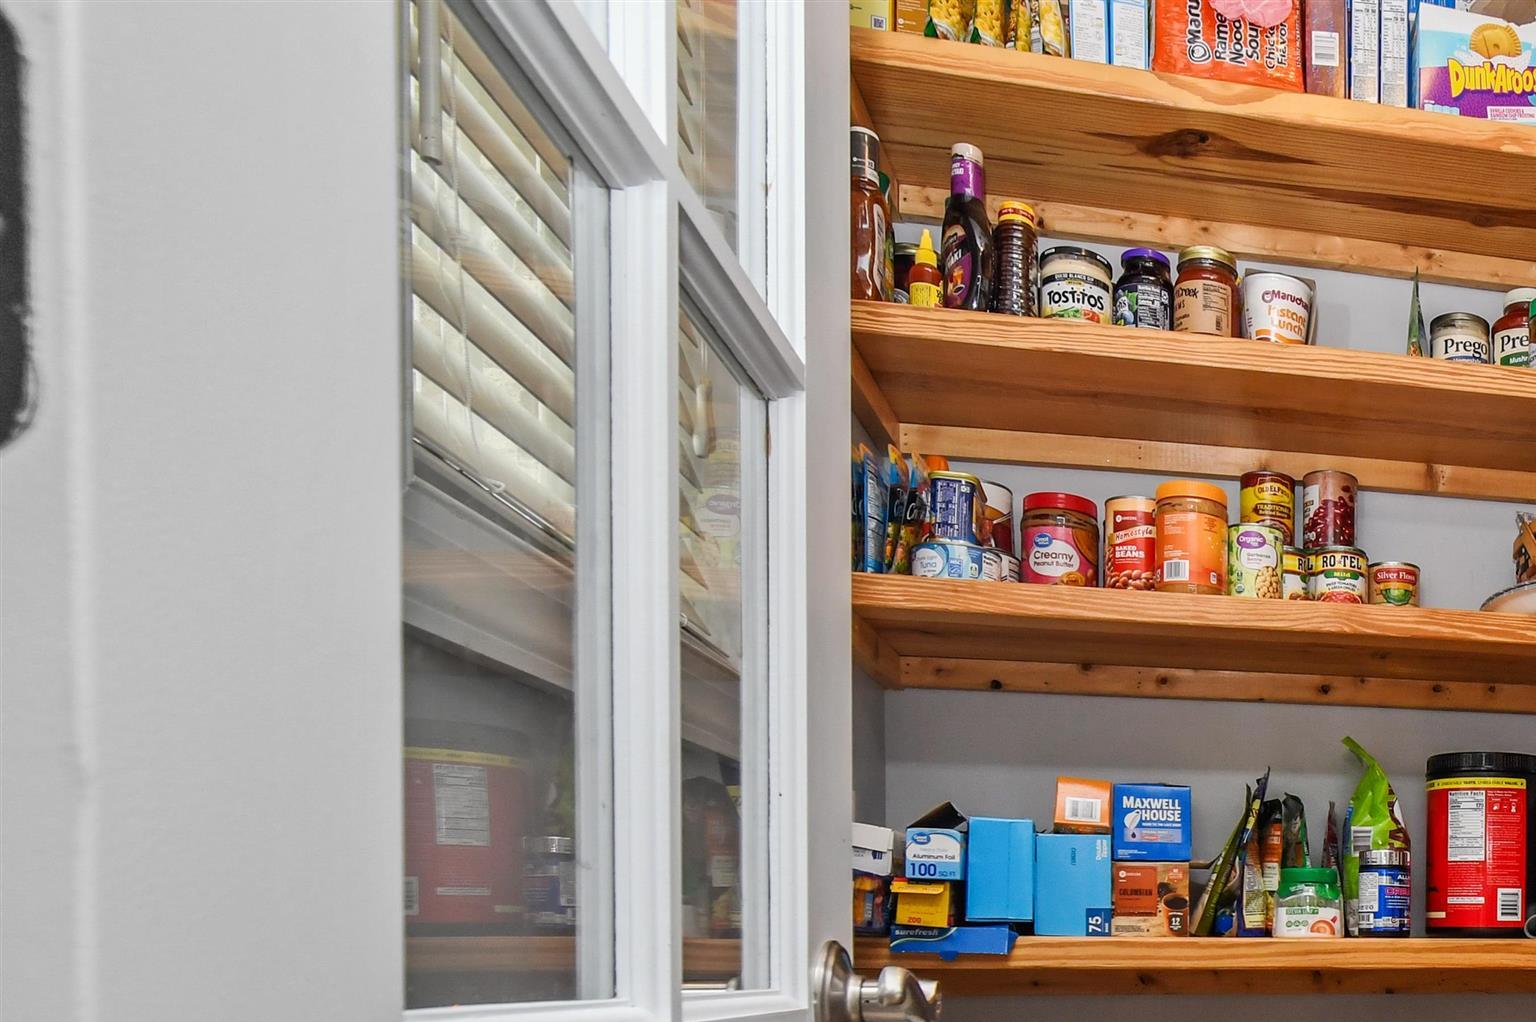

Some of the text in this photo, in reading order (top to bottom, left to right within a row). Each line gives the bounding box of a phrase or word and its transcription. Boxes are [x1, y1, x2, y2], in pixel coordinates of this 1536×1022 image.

[1499, 332, 1530, 351] Pre
[1443, 337, 1488, 359] Prego
[1115, 527, 1153, 541] Homestyle
[1238, 535, 1264, 545] Organic
[1033, 550, 1074, 562] Creamy
[1115, 550, 1145, 558] BEANS
[1376, 571, 1398, 581] Silver
[1122, 795, 1182, 810] MAXWELL
[1141, 810, 1182, 822] HOUSE
[909, 863, 937, 877] 100
[1088, 916, 1102, 933] 75
[1171, 917, 1180, 926] 12
[895, 928, 939, 937] surefresh
